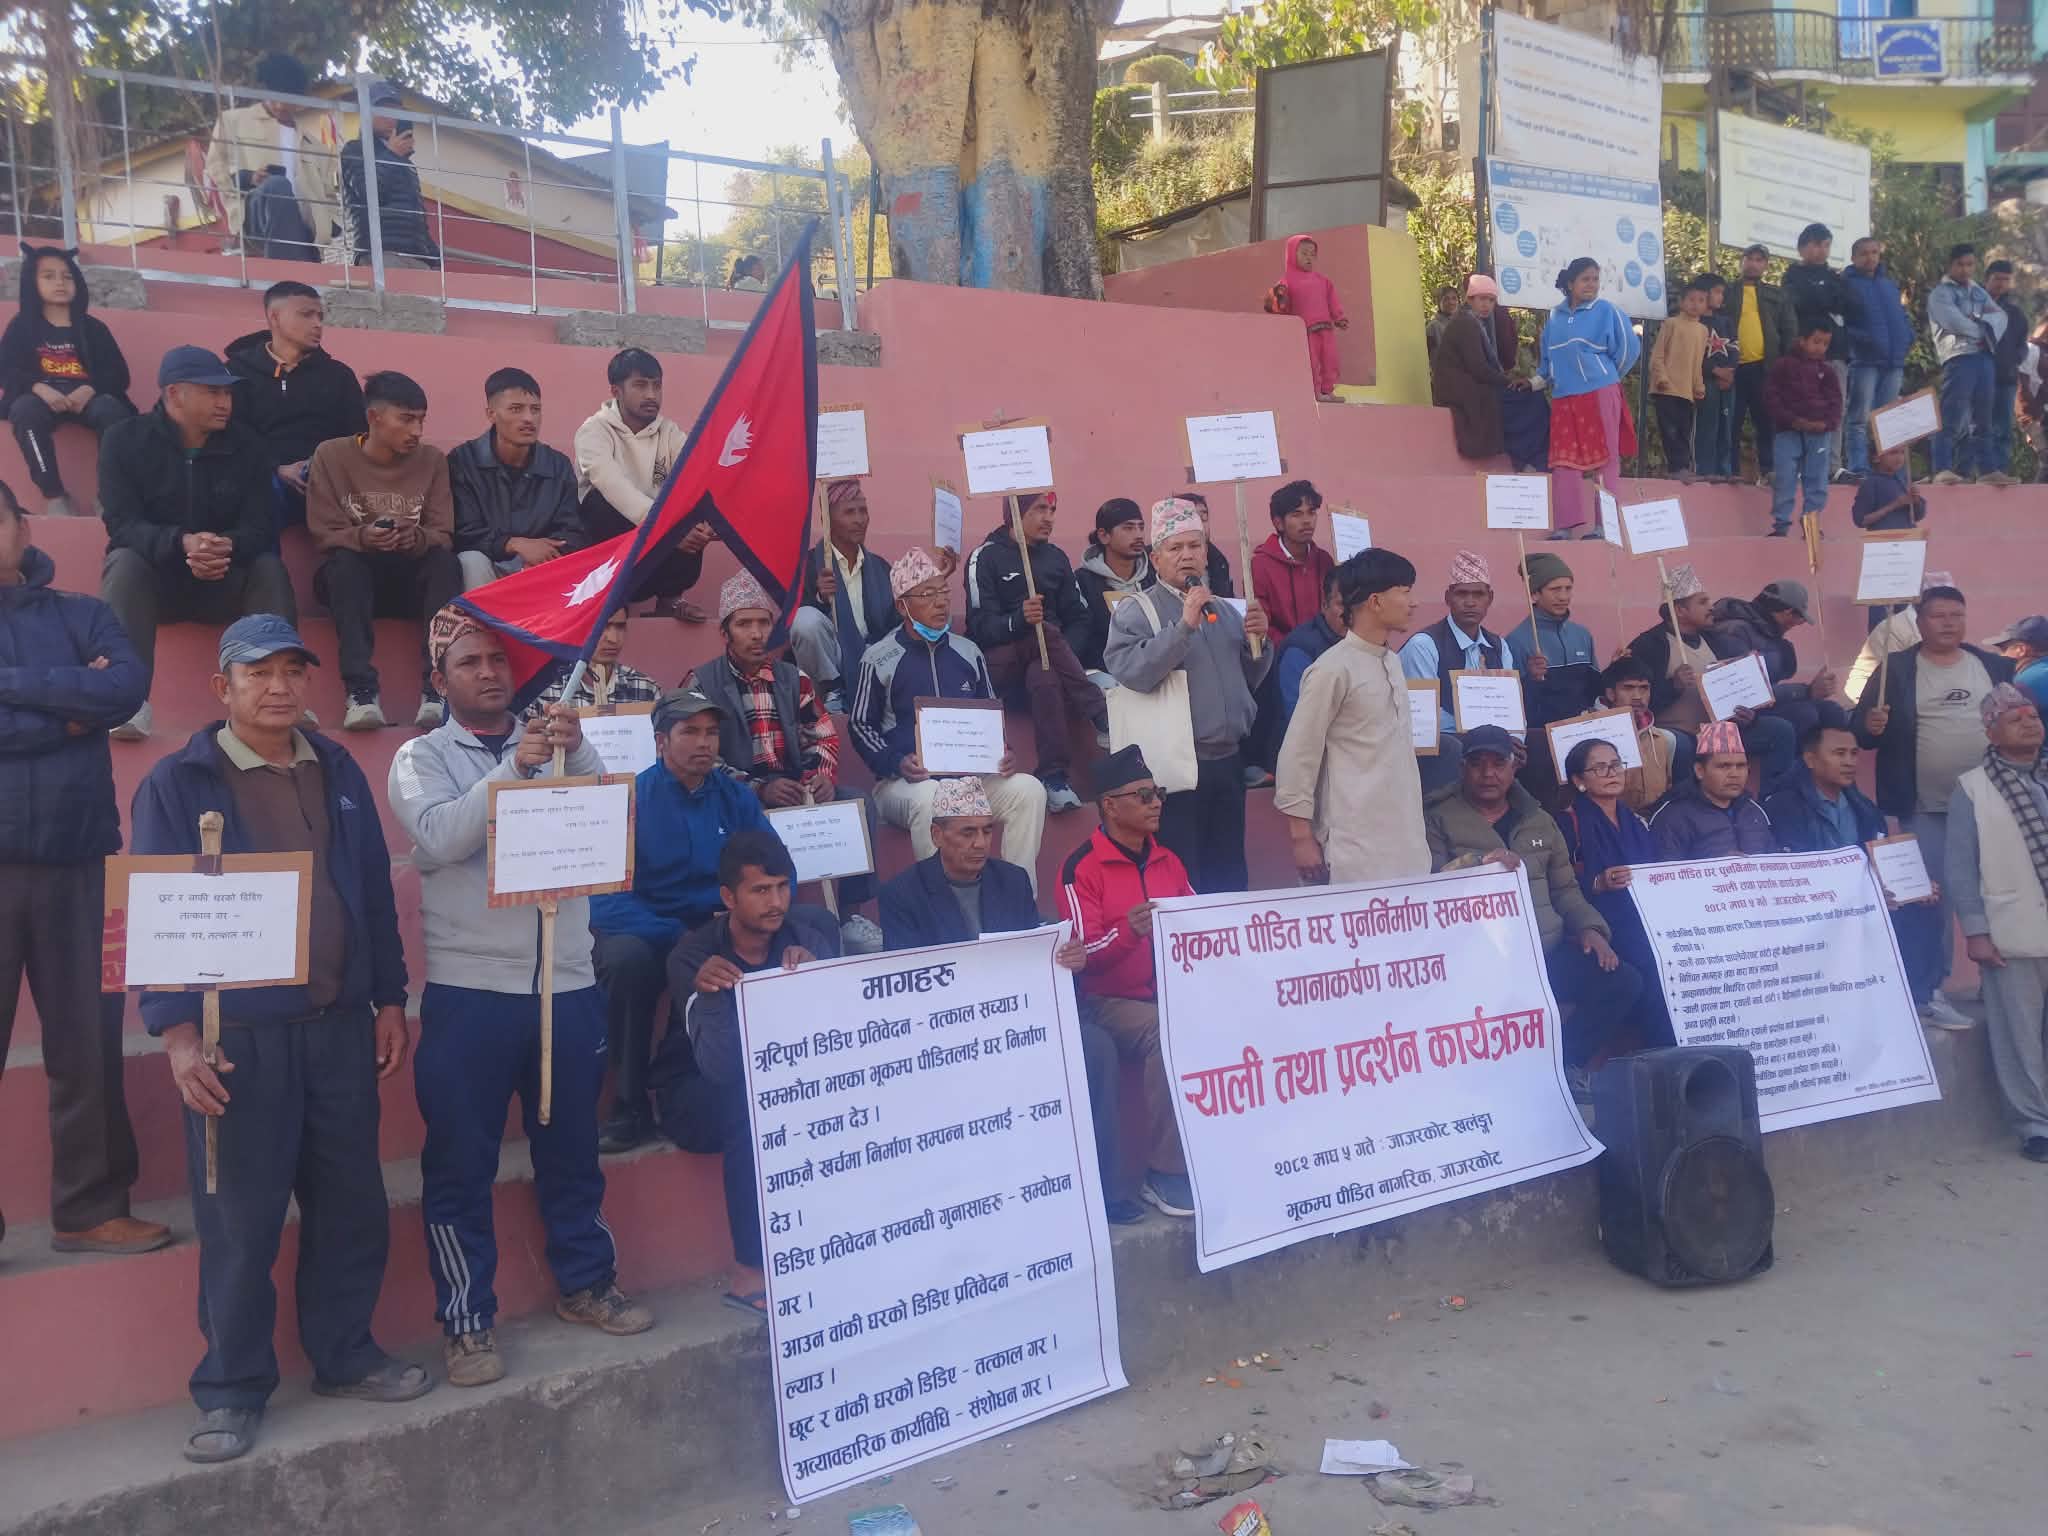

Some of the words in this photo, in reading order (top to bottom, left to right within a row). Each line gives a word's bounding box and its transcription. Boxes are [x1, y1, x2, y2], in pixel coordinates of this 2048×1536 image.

[1169, 926, 1241, 974] भूकम्प
[1244, 910, 1302, 953] पीडित
[1306, 913, 1337, 945] घर
[1339, 895, 1429, 950] पुनर्निर्माण
[1432, 890, 1520, 929] सम्बन्धमा
[1275, 957, 1382, 1008] ध्यानाकर्षण
[1385, 953, 1447, 989] गराउन
[812, 1028, 853, 1057] डिडिए
[856, 1018, 912, 1048] प्रतिवेदन
[928, 1004, 975, 1030] तत्काल
[1272, 1047, 1328, 1105] तथा
[1333, 1021, 1422, 1097] प्रदर्शन
[1425, 1005, 1546, 1069] कार्यक्रम
[758, 1077, 821, 1111] सम्झौता
[824, 1068, 865, 1094] भएका
[869, 1057, 913, 1087] भूकम्प
[917, 1037, 979, 1070] पीडितलाई
[983, 1036, 1002, 1055] घर
[1005, 1024, 1047, 1051] निर्माण
[761, 1123, 787, 1151] गर्न
[807, 1114, 844, 1140] रकम
[848, 1106, 869, 1129] देउ
[818, 1150, 862, 1178] खर्चमा
[865, 1136, 912, 1165] निर्माण
[915, 1123, 965, 1152] सम्पन्न
[968, 1106, 1013, 1137] घरलाई
[1028, 1099, 1062, 1122] रकम
[1274, 1155, 1310, 1177] २०८२
[1312, 1148, 1340, 1167] माघ
[1353, 1136, 1376, 1157] गते
[1385, 1121, 1451, 1150] जाजरकोट
[1286, 1193, 1332, 1222] भूकम्प
[1335, 1182, 1375, 1205] पीडित
[1437, 1149, 1503, 1180] जाजरकोट
[769, 1211, 791, 1235] देउ
[773, 1246, 816, 1277] डिडिए
[819, 1229, 877, 1265] प्रतिवेदन
[777, 1295, 802, 1317] गर
[781, 1329, 825, 1359] आउन
[866, 1298, 908, 1330] घरको
[911, 1288, 951, 1317] डिडिए
[953, 1271, 1009, 1305] प्रतिवेदन
[1026, 1252, 1073, 1281] तत्काल
[785, 1371, 825, 1400] ल्याउ
[819, 1409, 831, 1429] र
[873, 1377, 914, 1409] घरको
[917, 1366, 957, 1396] डिडिए
[974, 1344, 1023, 1376] तत्काल
[1026, 1336, 1048, 1357] गर
[889, 1406, 951, 1445] कार्यविधि
[967, 1386, 1018, 1419] संशोधन
[1020, 1377, 1042, 1399] गर
